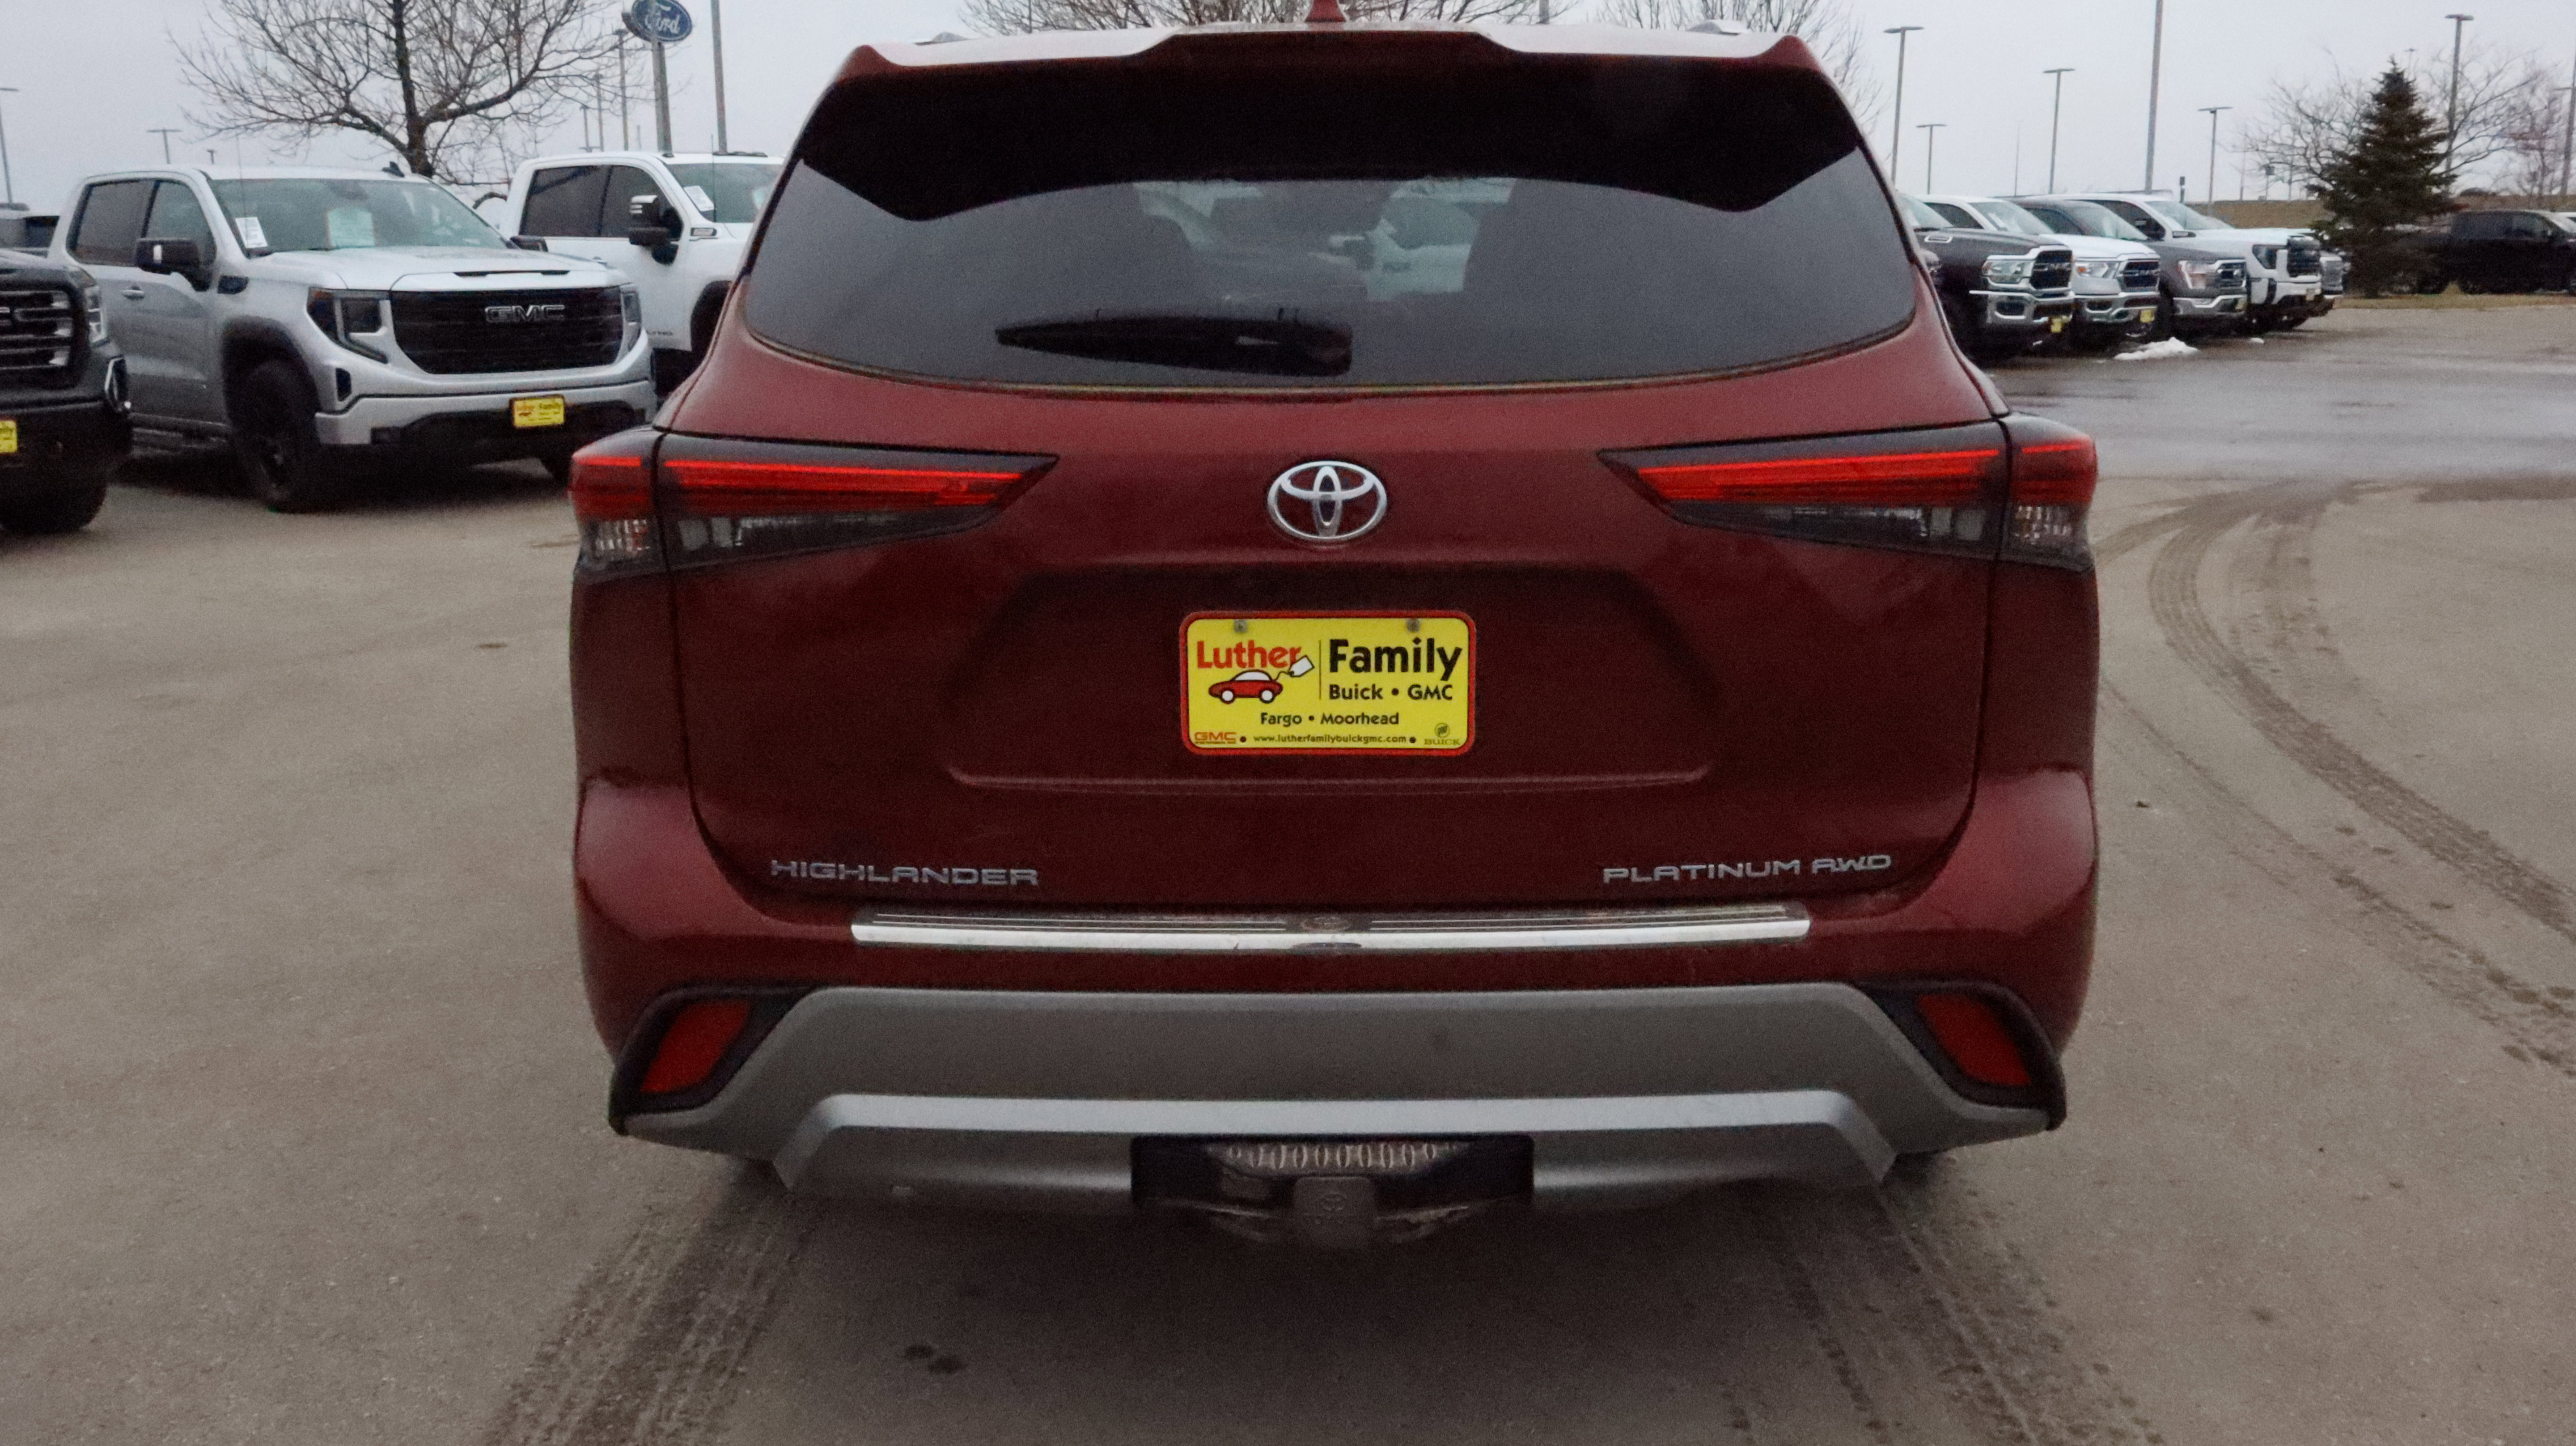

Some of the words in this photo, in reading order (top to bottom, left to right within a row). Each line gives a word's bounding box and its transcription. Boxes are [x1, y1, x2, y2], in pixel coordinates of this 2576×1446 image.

[485, 304, 565, 322] GMC
[1197, 639, 1302, 669] Luther
[1329, 637, 1463, 681] Family
[1329, 684, 1383, 700] Buick
[1407, 684, 1453, 700] GMC
[1260, 712, 1302, 727] Fargo
[1320, 712, 1399, 725] Moorhead
[1194, 732, 1236, 741] GMC
[1253, 734, 1407, 744] www.lutherfamilybuickgmc.com
[771, 860, 1038, 886] HIGHLANDER
[1603, 860, 1801, 883] PLATINUM
[1812, 854, 1892, 874] AWD
